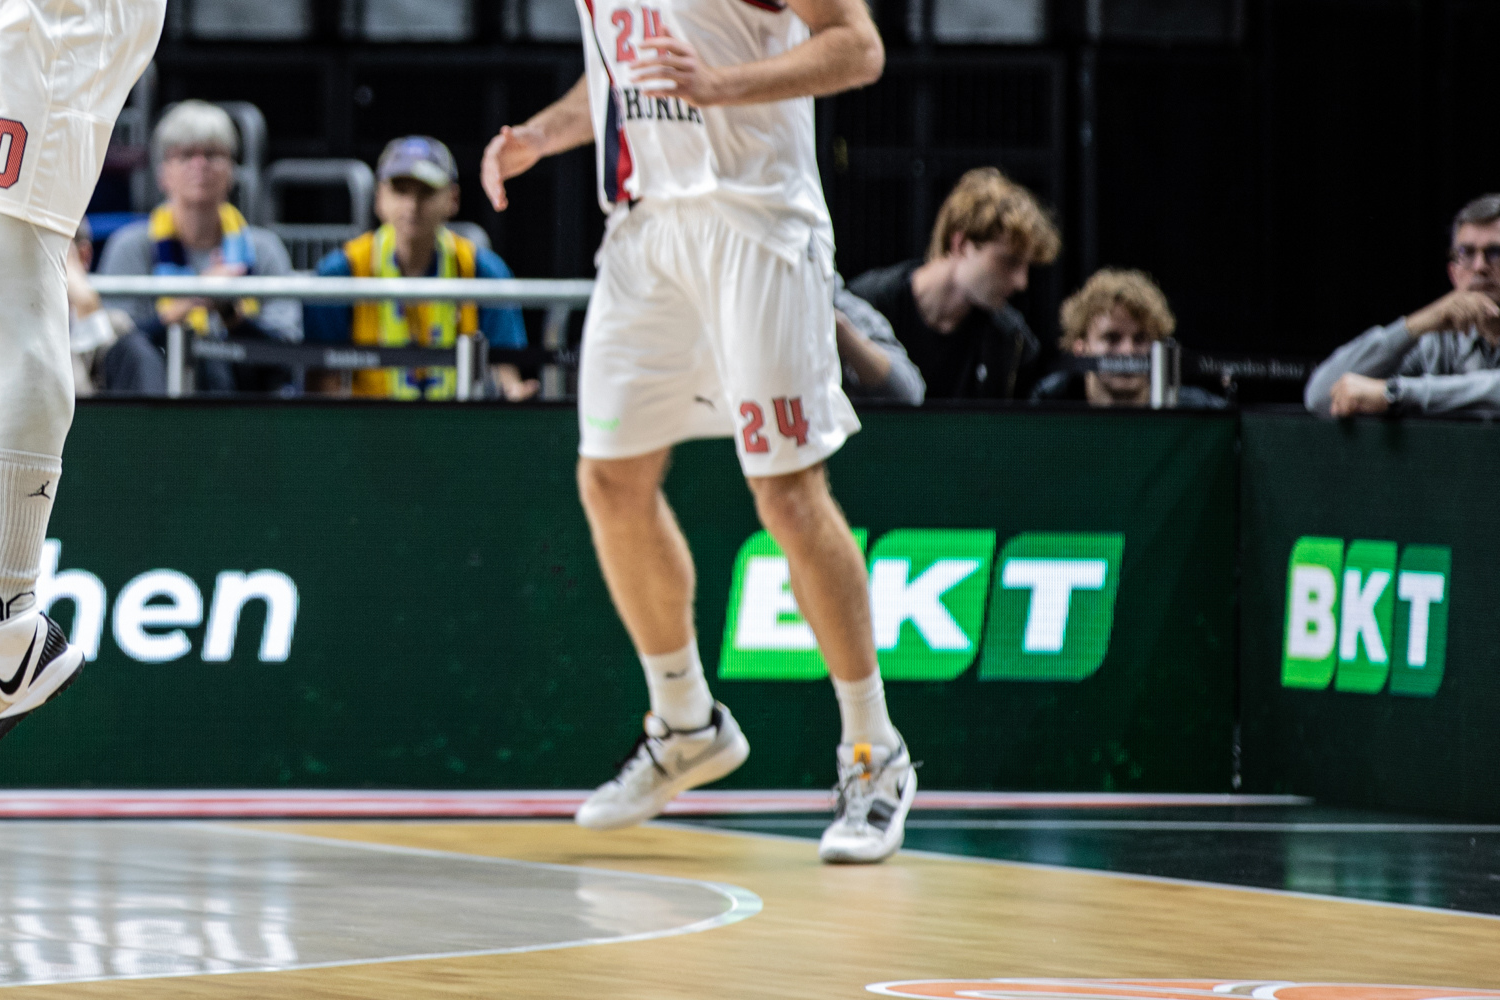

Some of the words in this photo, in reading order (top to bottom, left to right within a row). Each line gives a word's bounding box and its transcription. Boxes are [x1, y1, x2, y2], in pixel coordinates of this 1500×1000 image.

[740, 396, 809, 454] 24
[731, 556, 1110, 654] BKT
[1284, 563, 1447, 668] BKT
